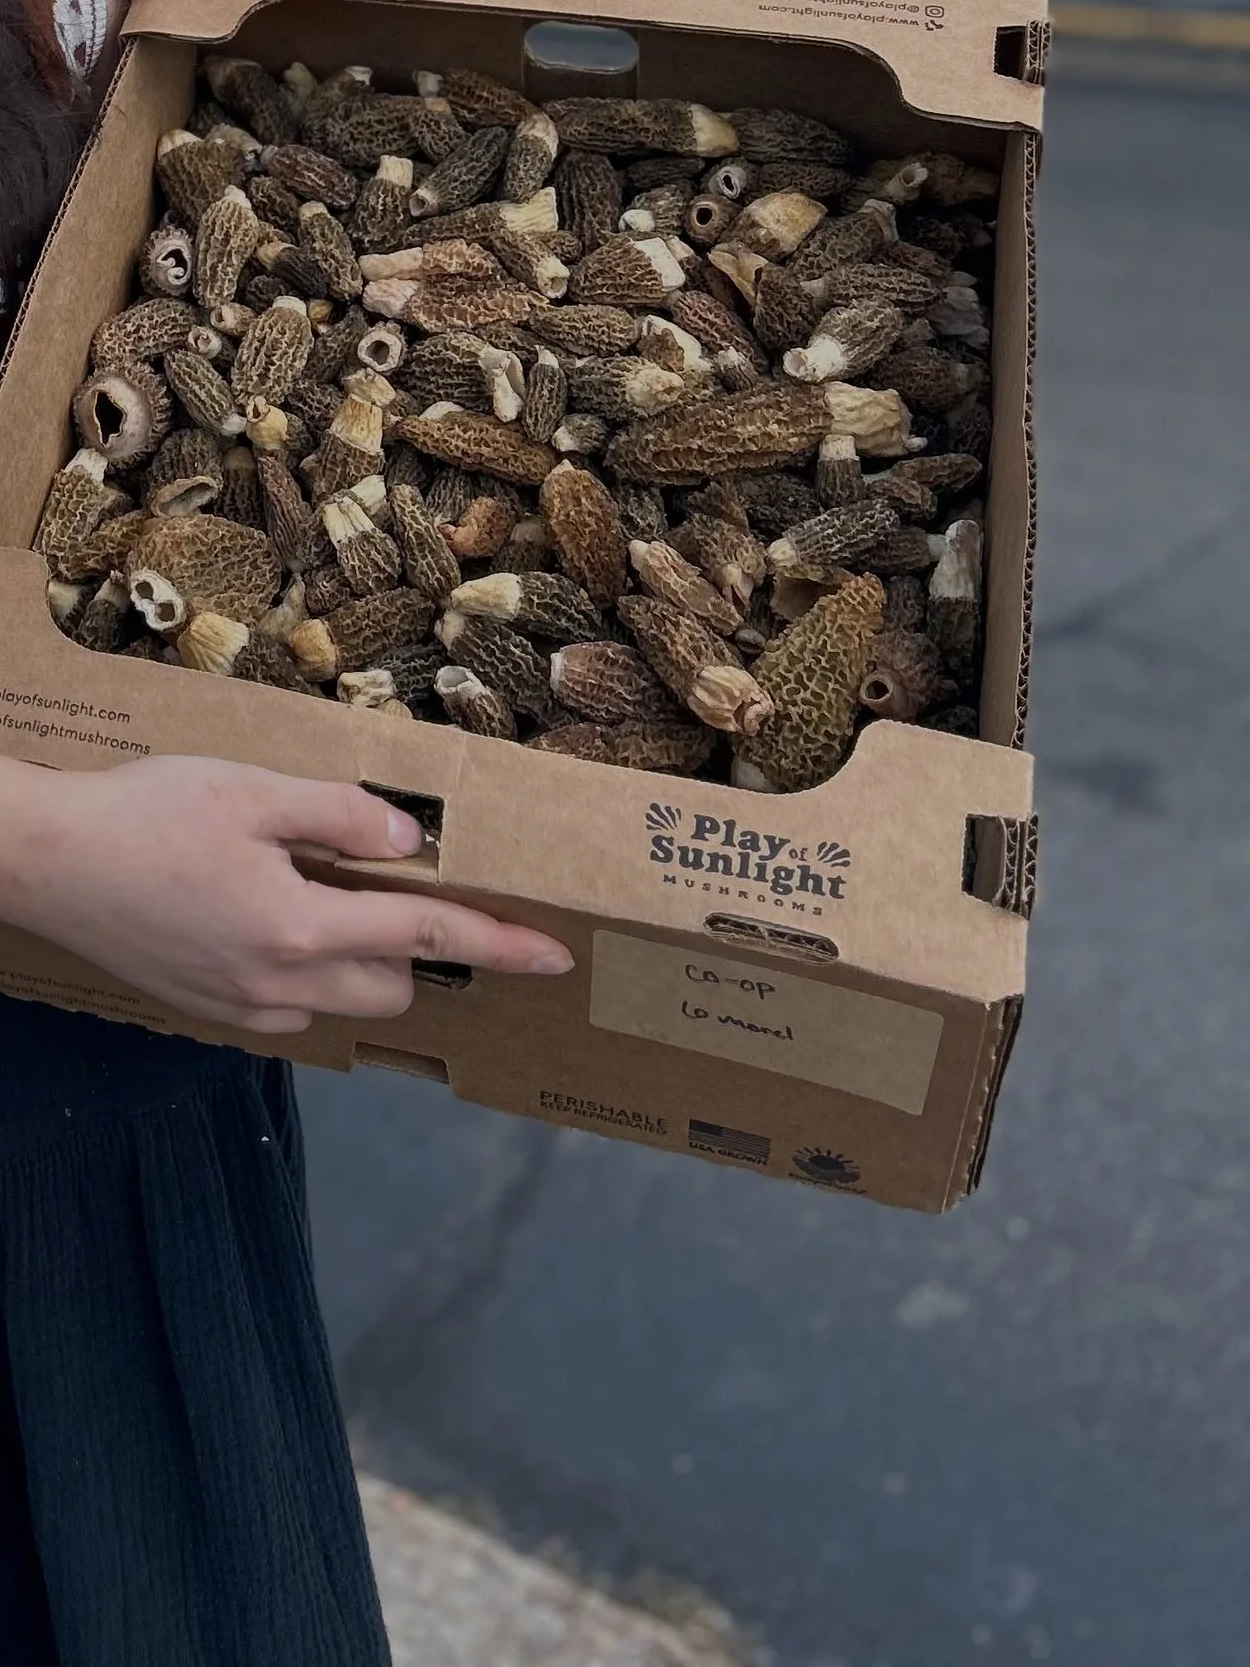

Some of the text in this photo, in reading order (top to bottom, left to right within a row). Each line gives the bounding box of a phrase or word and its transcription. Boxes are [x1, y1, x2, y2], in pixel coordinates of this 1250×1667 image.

[758, 4, 919, 27] www.playofsunlight.com
[690, 813, 809, 862] Play of
[650, 834, 848, 900] Sunlight
[662, 873, 824, 916] MUSHROOMS
[539, 1090, 669, 1127] PERISHABLE
[540, 1100, 668, 1135] KEEP REFRIGERATED
[688, 1141, 714, 1154] USA
